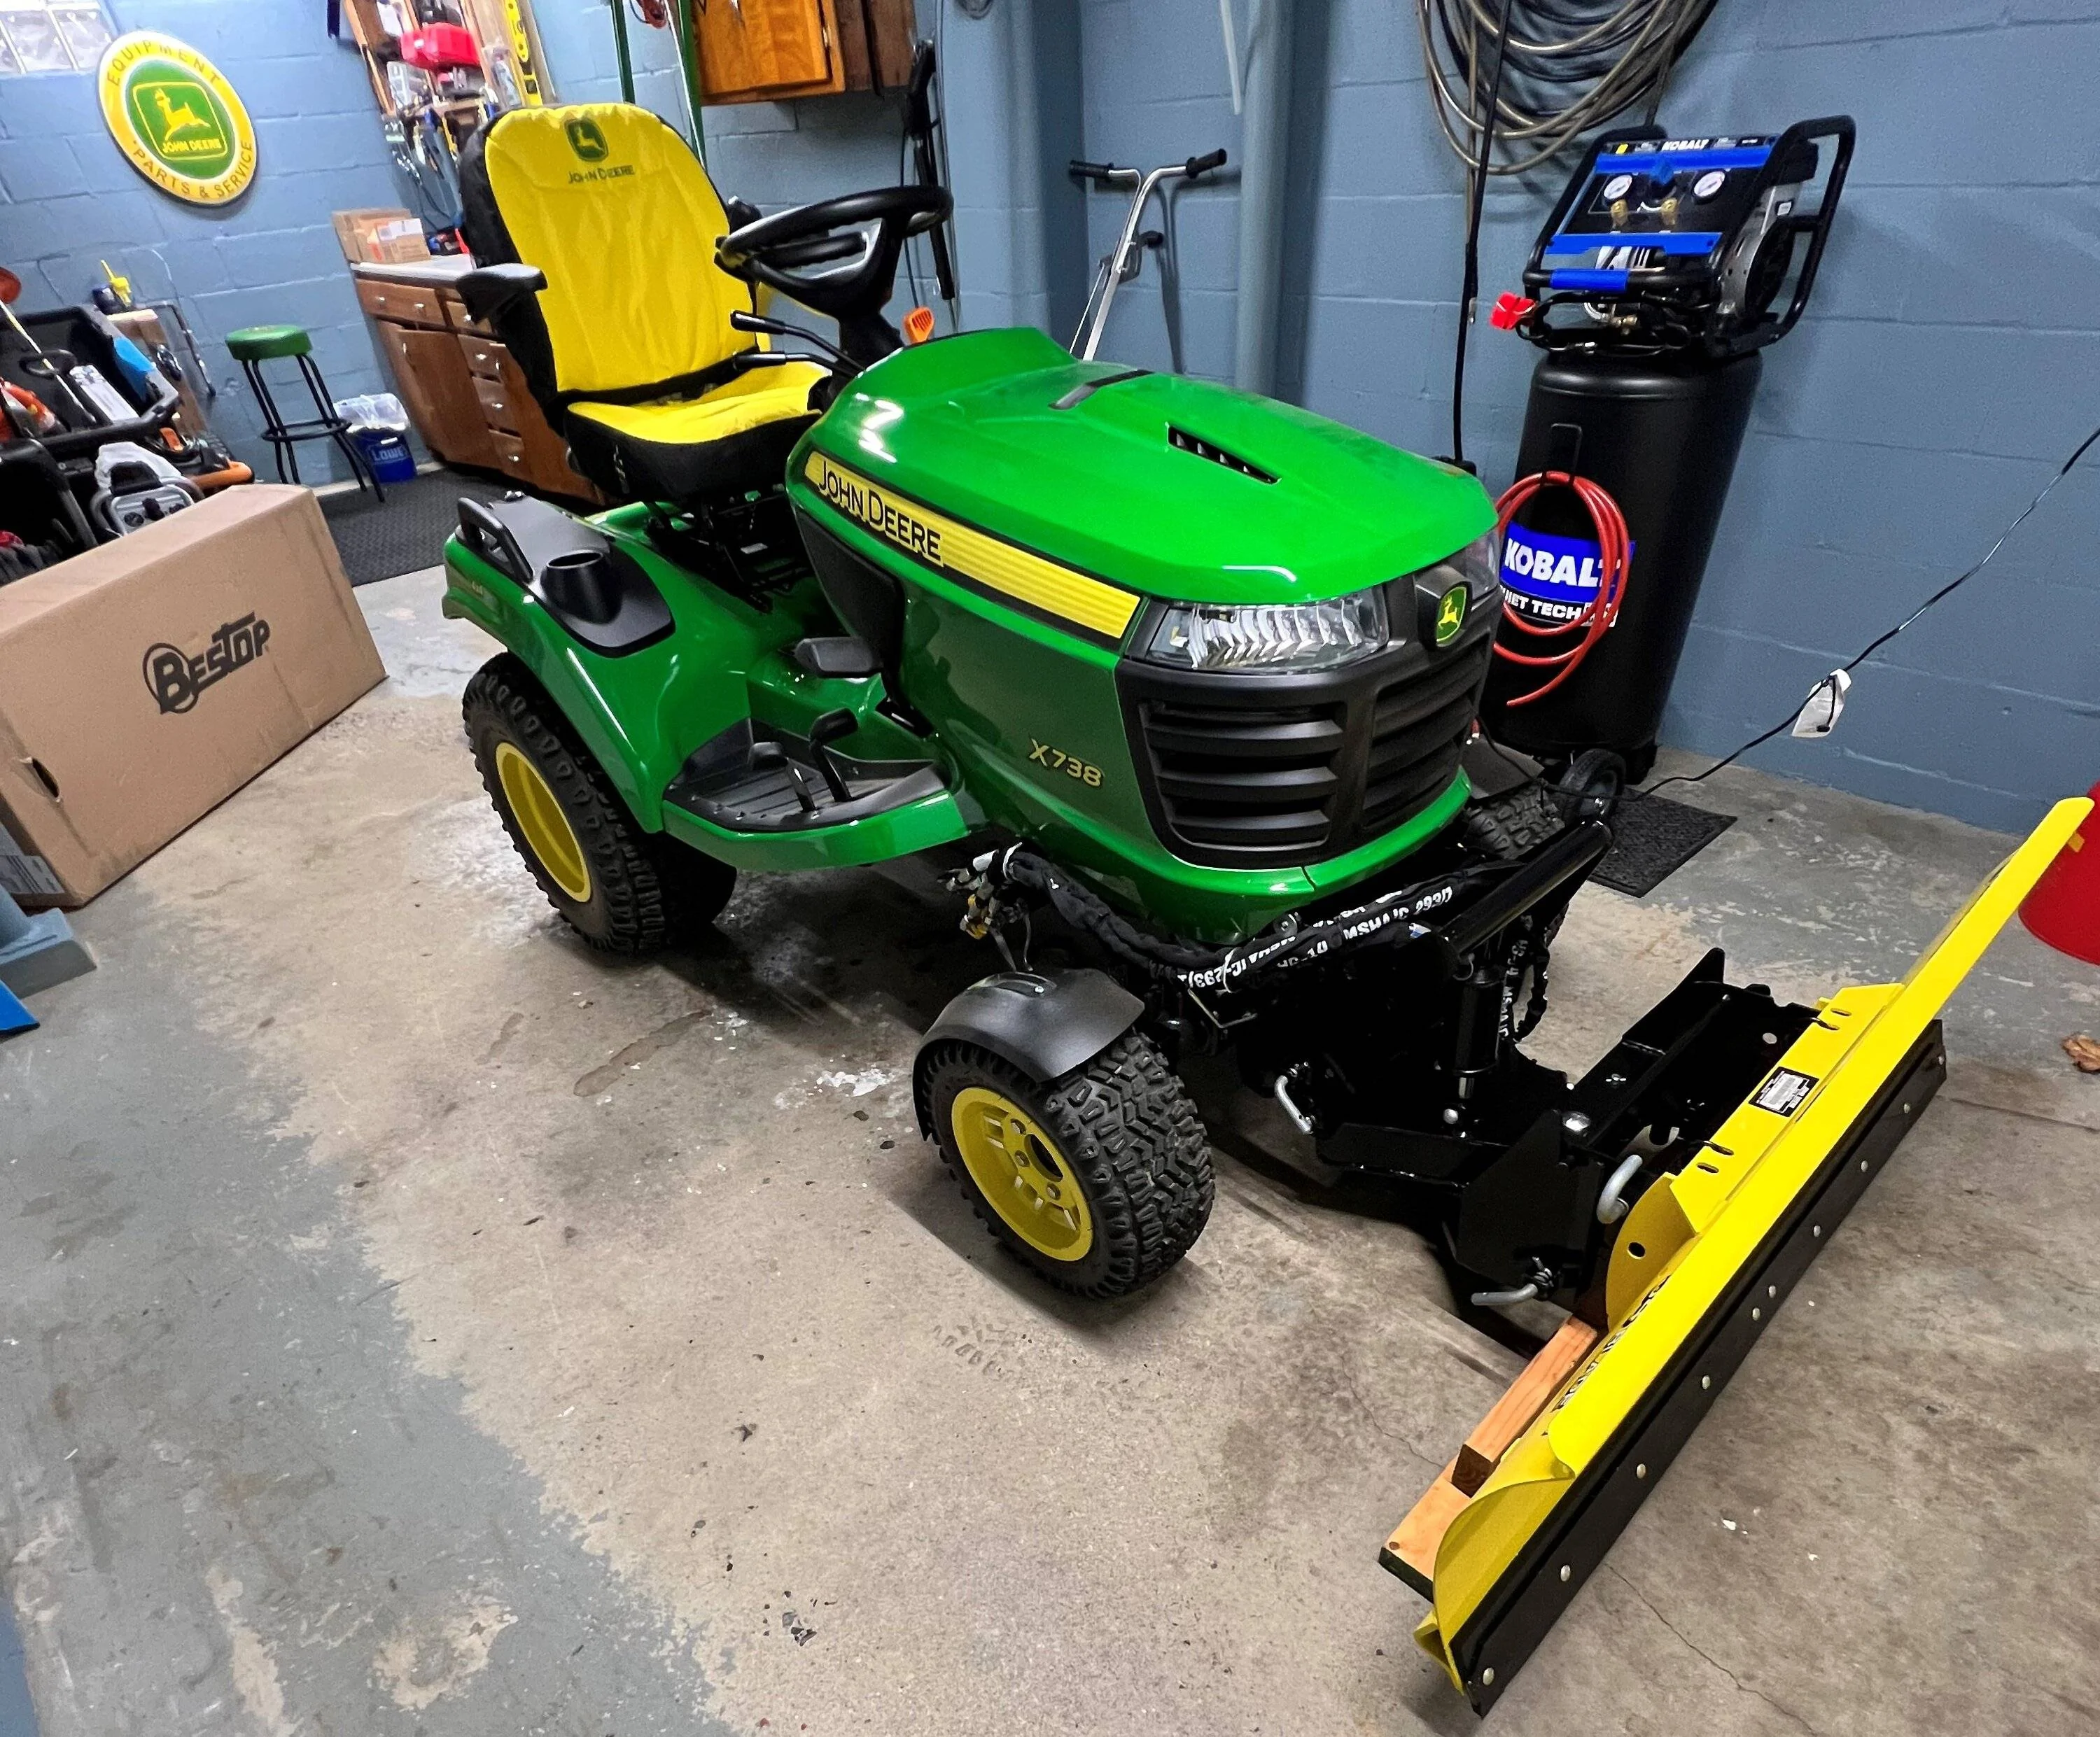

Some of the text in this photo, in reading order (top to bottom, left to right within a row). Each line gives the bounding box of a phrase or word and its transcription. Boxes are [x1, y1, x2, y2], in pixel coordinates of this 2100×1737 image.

[107, 39, 220, 87] EQUIPMENT
[162, 138, 222, 153] JOHN DEERE
[1661, 139, 1709, 151] KOBALT
[133, 140, 253, 199] PARTS & SERVICE
[568, 164, 635, 185] JOHN DEERE
[818, 460, 941, 562] JOHN DEERE
[1531, 600, 1583, 619] TECH
[143, 610, 271, 715] BESTOP
[1028, 738, 1102, 787] X738
